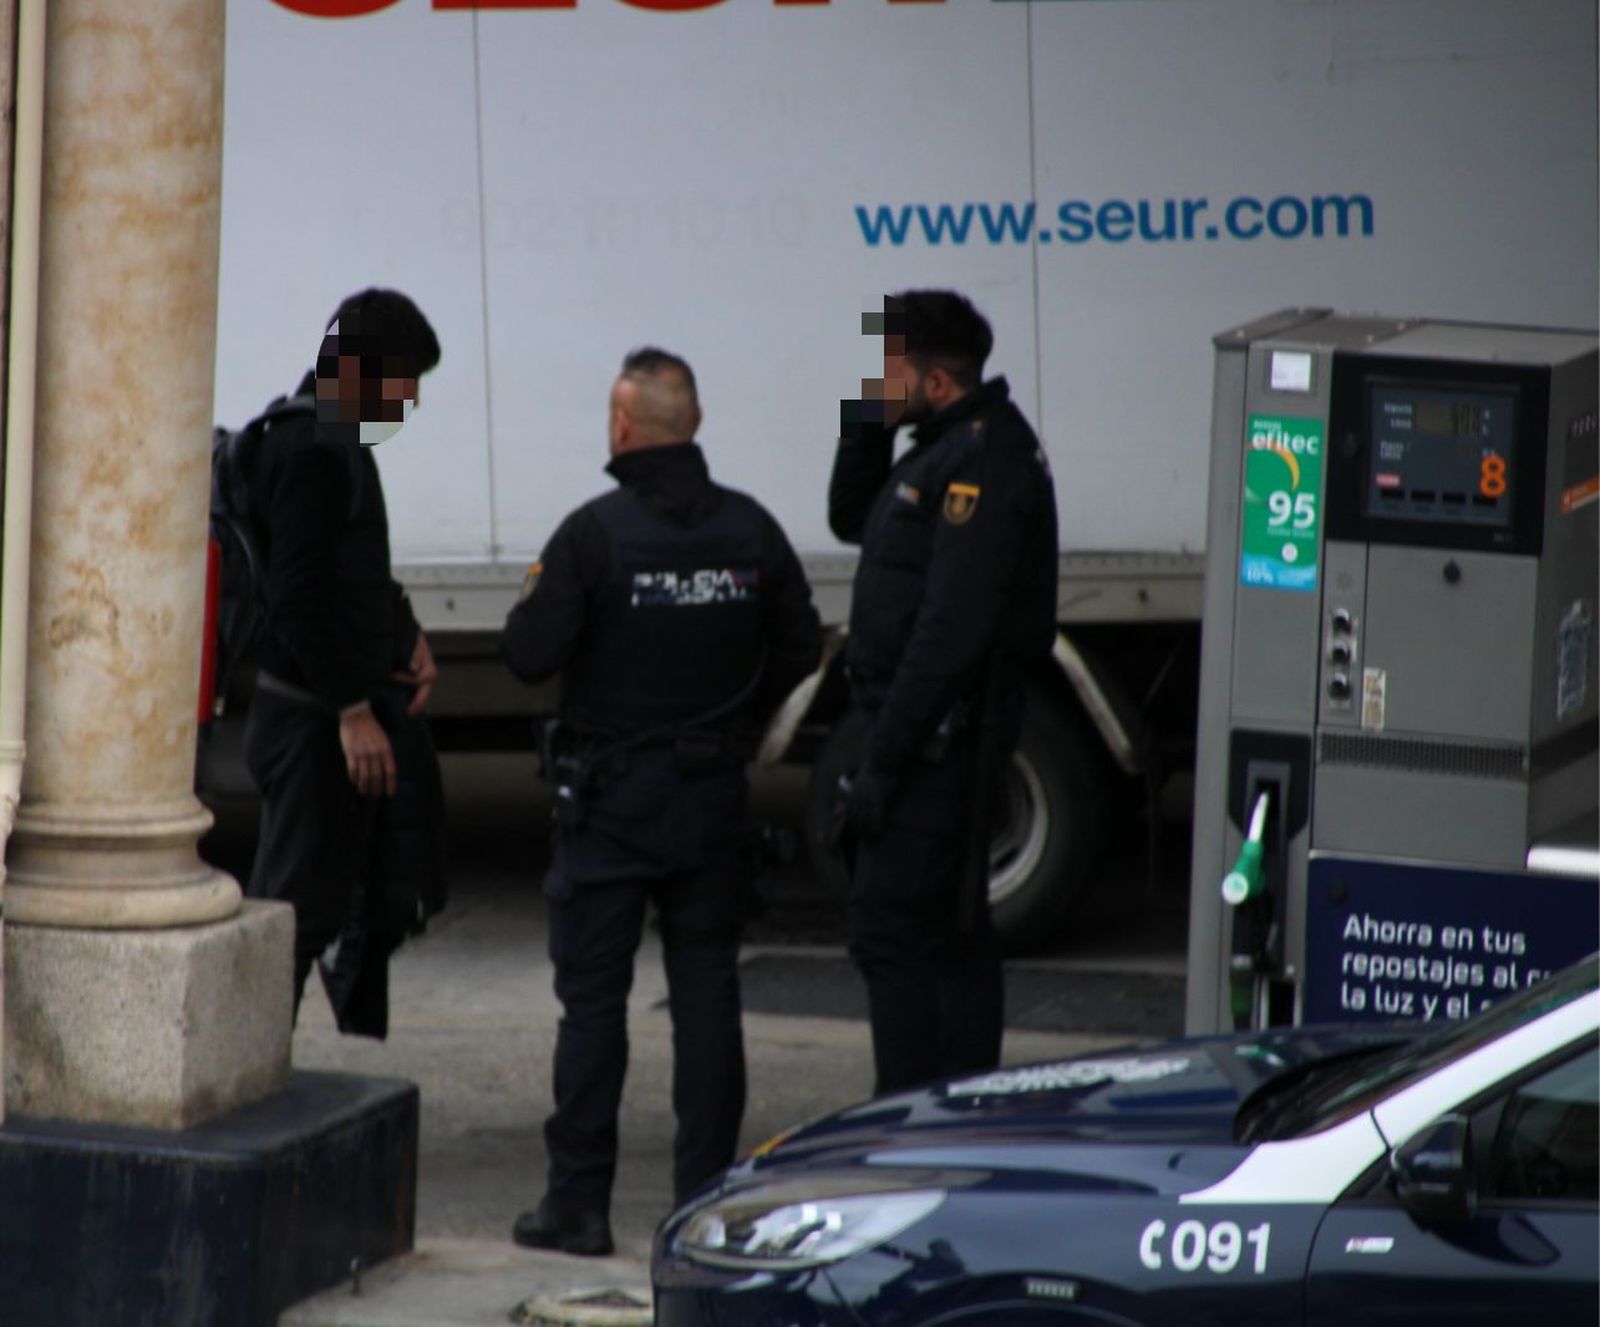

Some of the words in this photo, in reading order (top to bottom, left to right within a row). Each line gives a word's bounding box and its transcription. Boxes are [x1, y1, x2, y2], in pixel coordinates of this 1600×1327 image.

[856, 192, 1375, 246] www.seur.com
[1480, 456, 1507, 497] 8
[1268, 490, 1315, 528] 95
[1343, 913, 1432, 948] Ahorra
[1441, 926, 1473, 950] en
[1482, 926, 1526, 955] tus
[1342, 952, 1484, 990] repostajes
[1492, 961, 1518, 989] al
[1340, 982, 1367, 1011] la
[1374, 984, 1414, 1015] luz
[1422, 993, 1439, 1022] y
[1446, 993, 1470, 1020] el
[1171, 1219, 1271, 1274] 091
